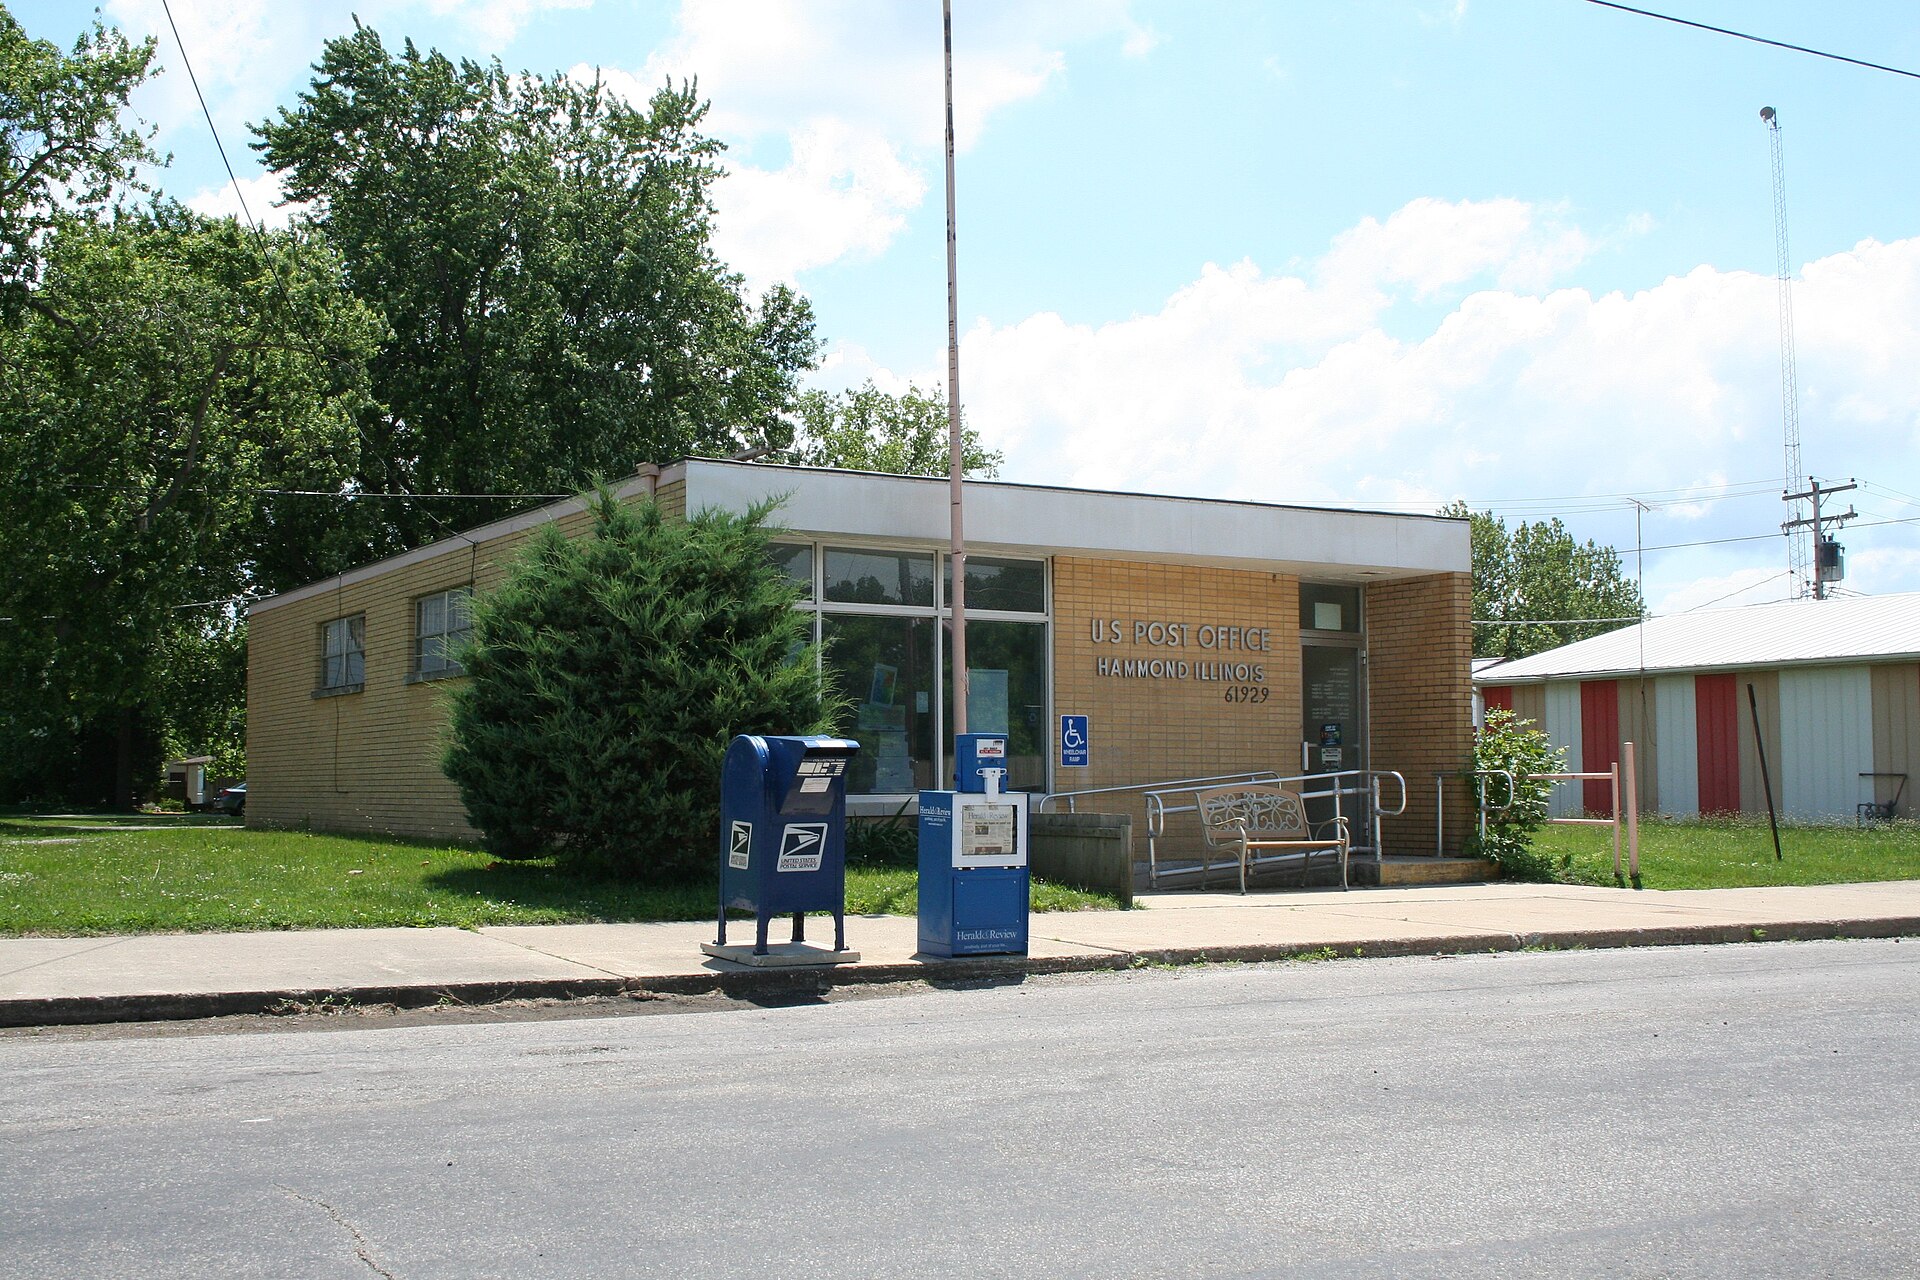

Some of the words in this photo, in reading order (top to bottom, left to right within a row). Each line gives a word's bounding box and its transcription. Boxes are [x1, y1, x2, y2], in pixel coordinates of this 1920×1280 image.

[1134, 621, 1190, 647] POST
[1198, 625, 1271, 651] OFFICE
[1098, 657, 1189, 679] HAMMOND
[1194, 661, 1265, 683] ILLINOIS
[1224, 685, 1270, 704] 61929
